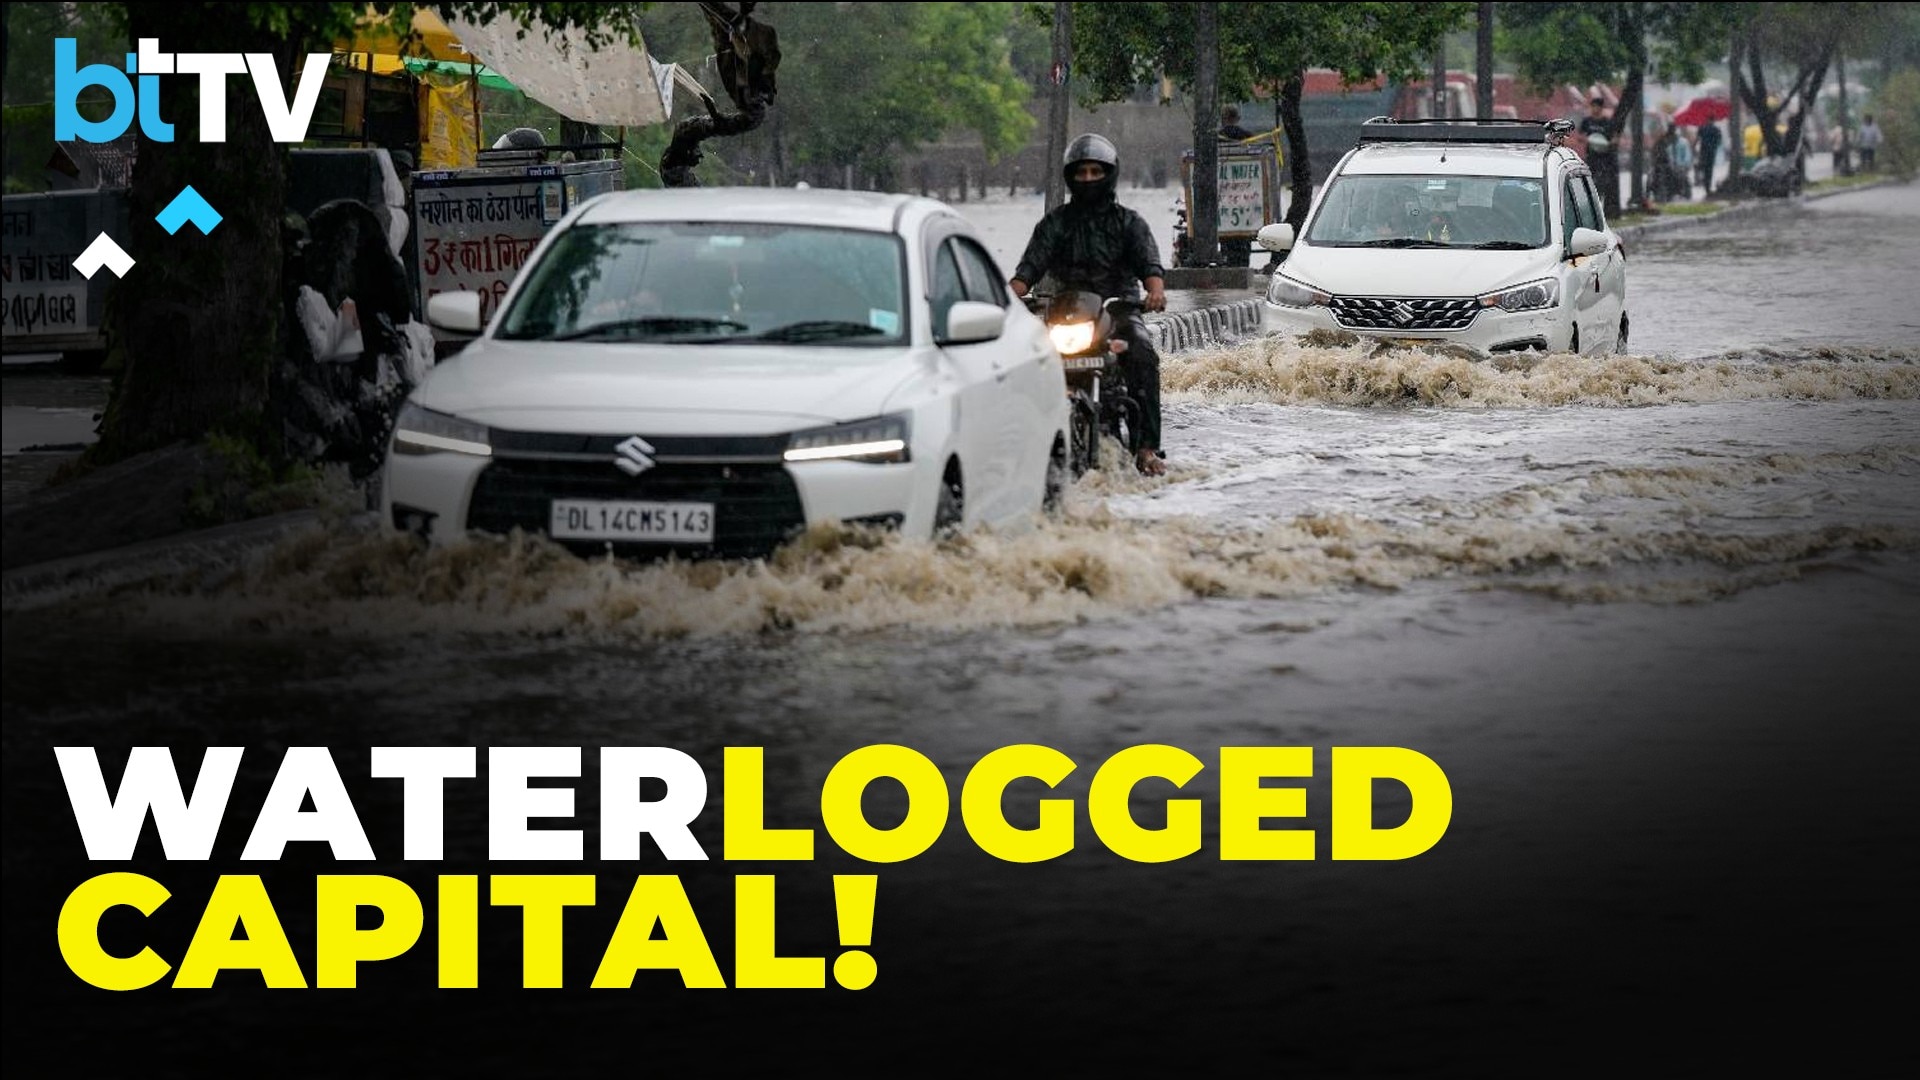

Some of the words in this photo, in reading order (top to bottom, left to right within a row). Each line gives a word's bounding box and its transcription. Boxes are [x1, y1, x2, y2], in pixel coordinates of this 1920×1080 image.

[466, 198, 484, 222] का
[487, 191, 510, 222] ठंडा
[568, 506, 710, 533] DL14CM5143
